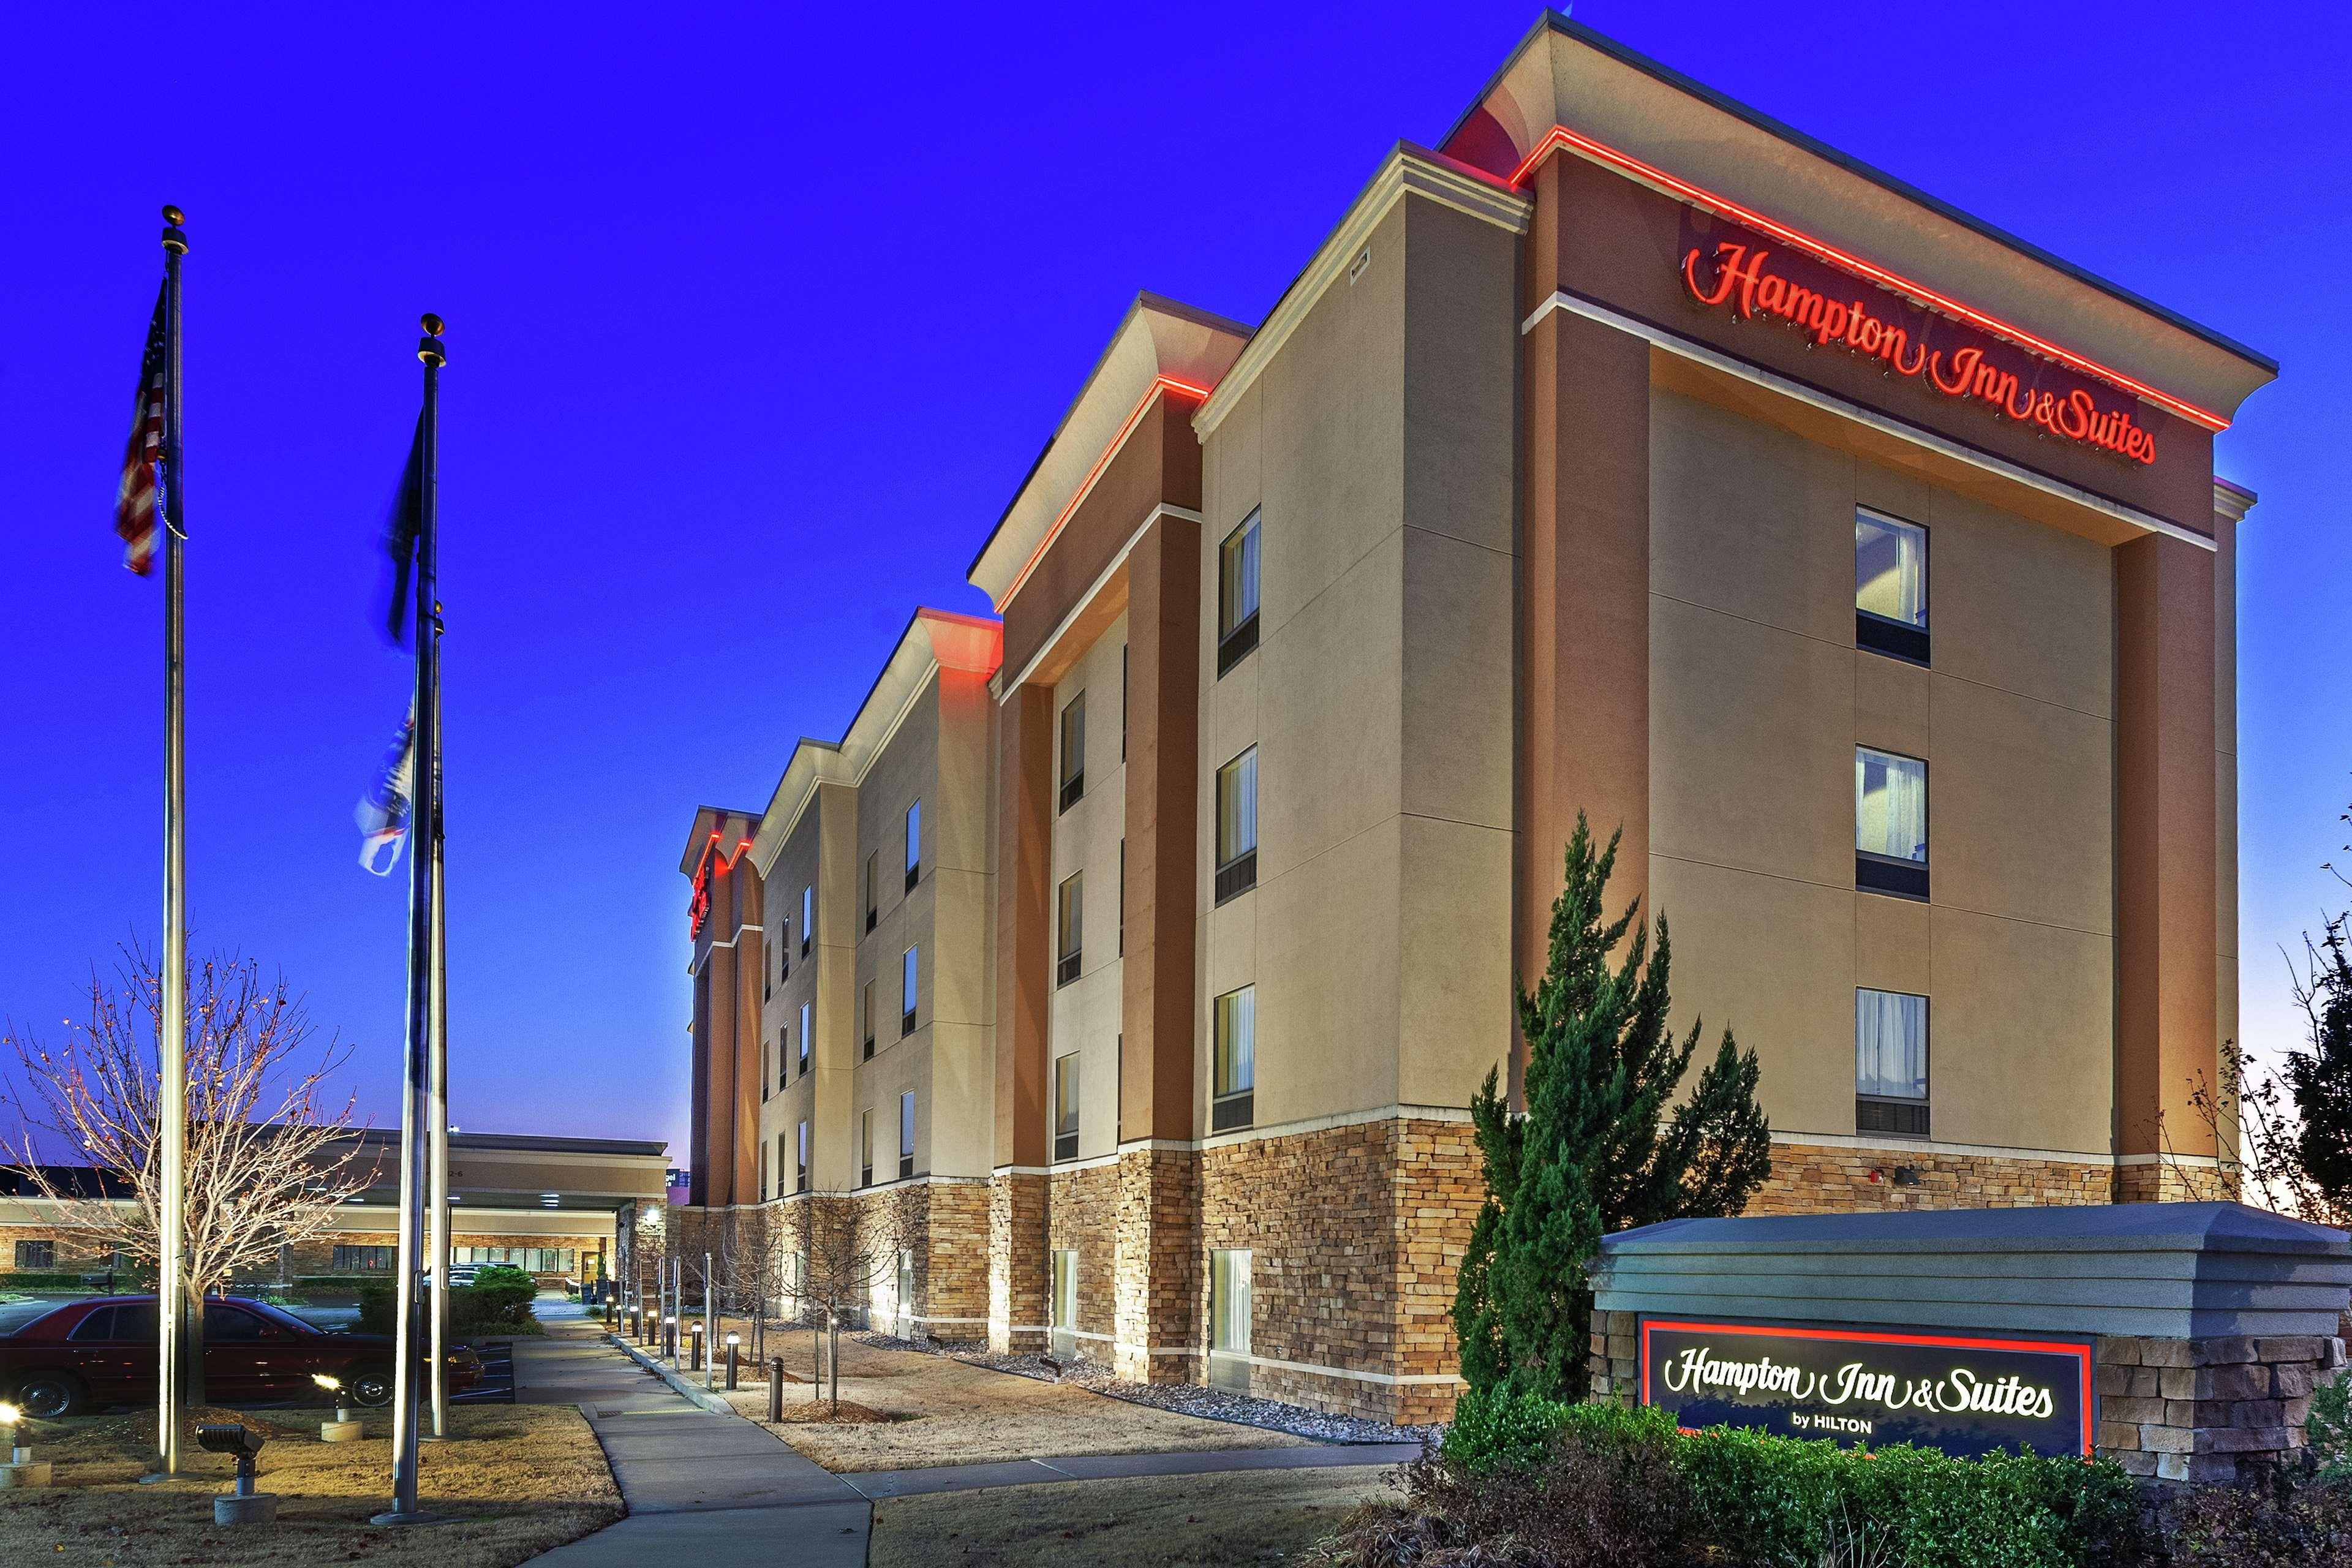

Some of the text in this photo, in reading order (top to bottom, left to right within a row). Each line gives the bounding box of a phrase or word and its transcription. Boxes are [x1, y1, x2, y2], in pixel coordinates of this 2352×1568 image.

[1686, 243, 1926, 375] Hampton
[1931, 347, 2037, 420] Inn
[1664, 1347, 1815, 1400] Hampton
[1819, 1362, 1913, 1409] Inn
[1792, 1412, 1872, 1434] by HILTON
